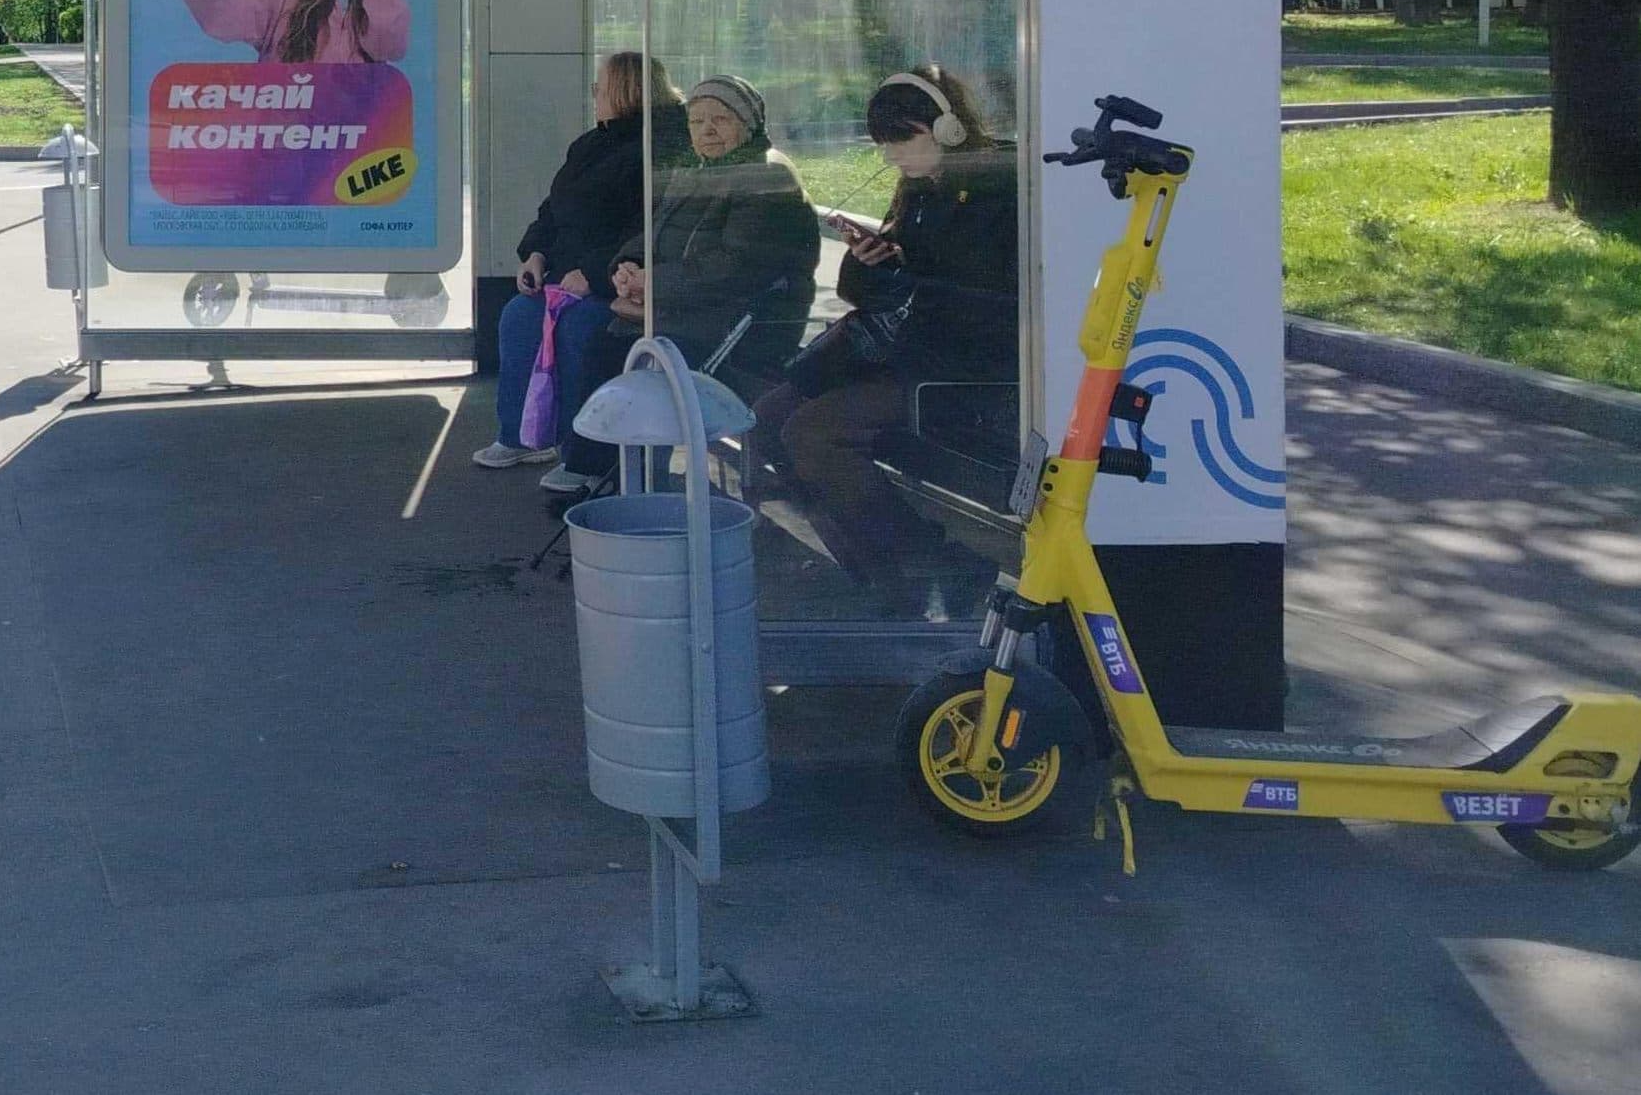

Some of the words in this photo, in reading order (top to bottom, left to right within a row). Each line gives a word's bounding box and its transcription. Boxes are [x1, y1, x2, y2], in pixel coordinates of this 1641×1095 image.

[168, 73, 314, 109] качай
[168, 125, 367, 150] контент
[347, 154, 405, 198] LIKE
[1101, 641, 1127, 675] ВТБ
[1265, 786, 1297, 801] ВТБ
[1453, 793, 1522, 816] ВЕЗЁТ
